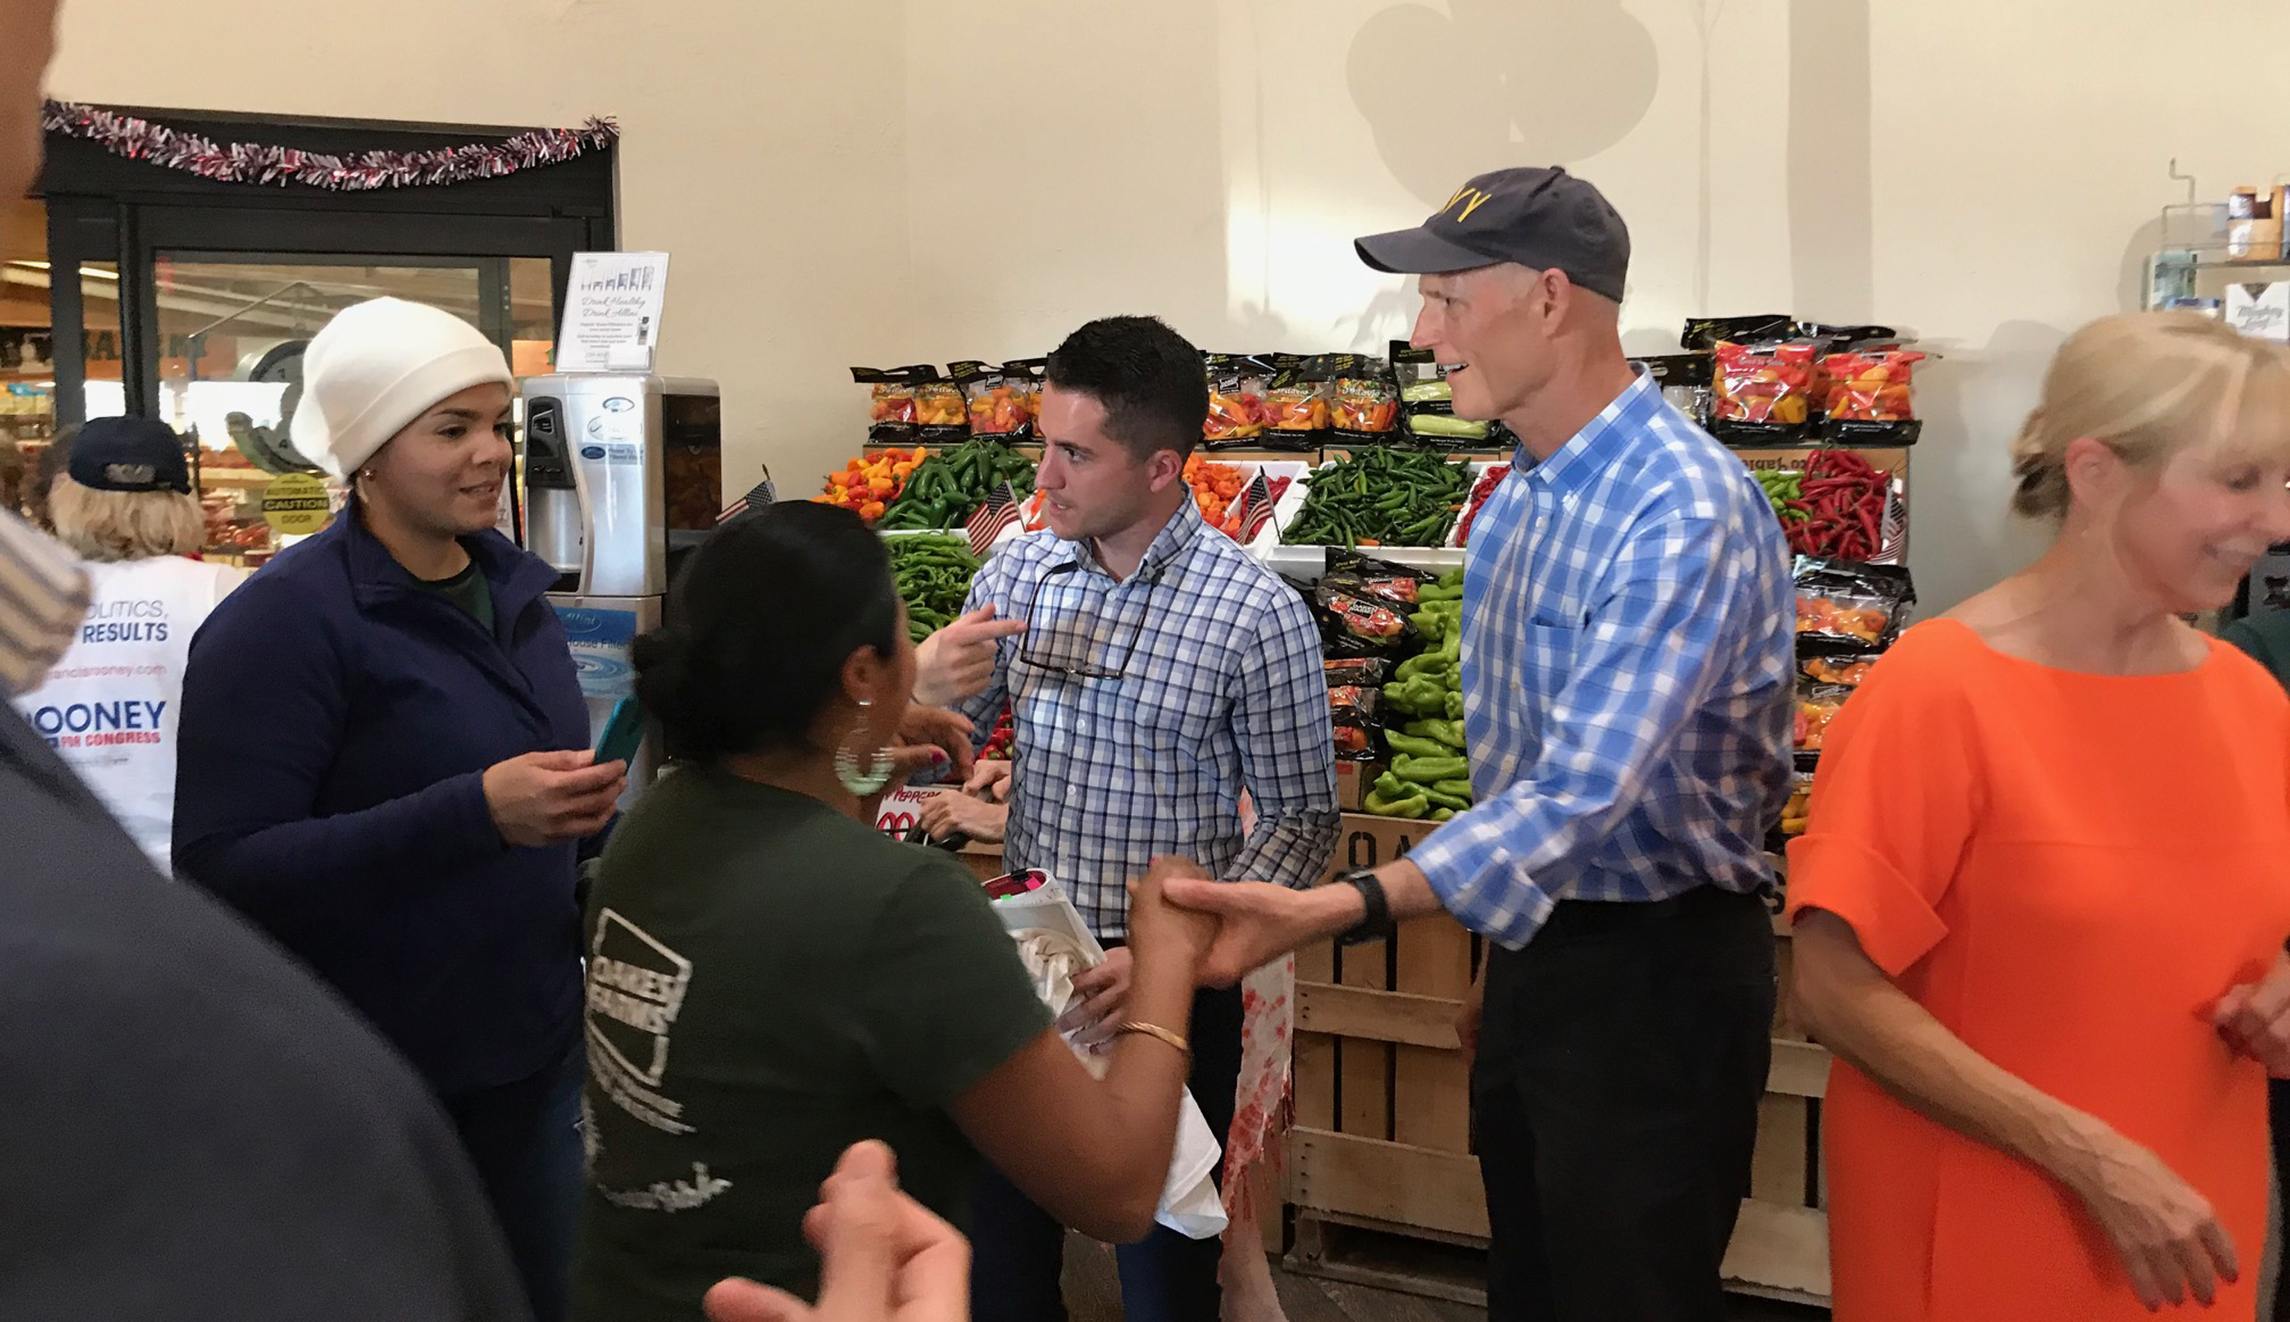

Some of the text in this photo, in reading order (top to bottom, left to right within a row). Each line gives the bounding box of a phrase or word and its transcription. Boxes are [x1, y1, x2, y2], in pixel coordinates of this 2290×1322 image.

[581, 297, 646, 309] Drink Healthy
[583, 309, 612, 318] Drink
[266, 486, 327, 496] AUTOMATIC
[265, 499, 328, 510] CAUTION
[281, 514, 311, 525] DOOR
[86, 600, 169, 620] OLITICS,
[82, 622, 168, 644] RESULTS
[27, 700, 167, 735] OONEY
[60, 731, 161, 748] FOR CONGRESS
